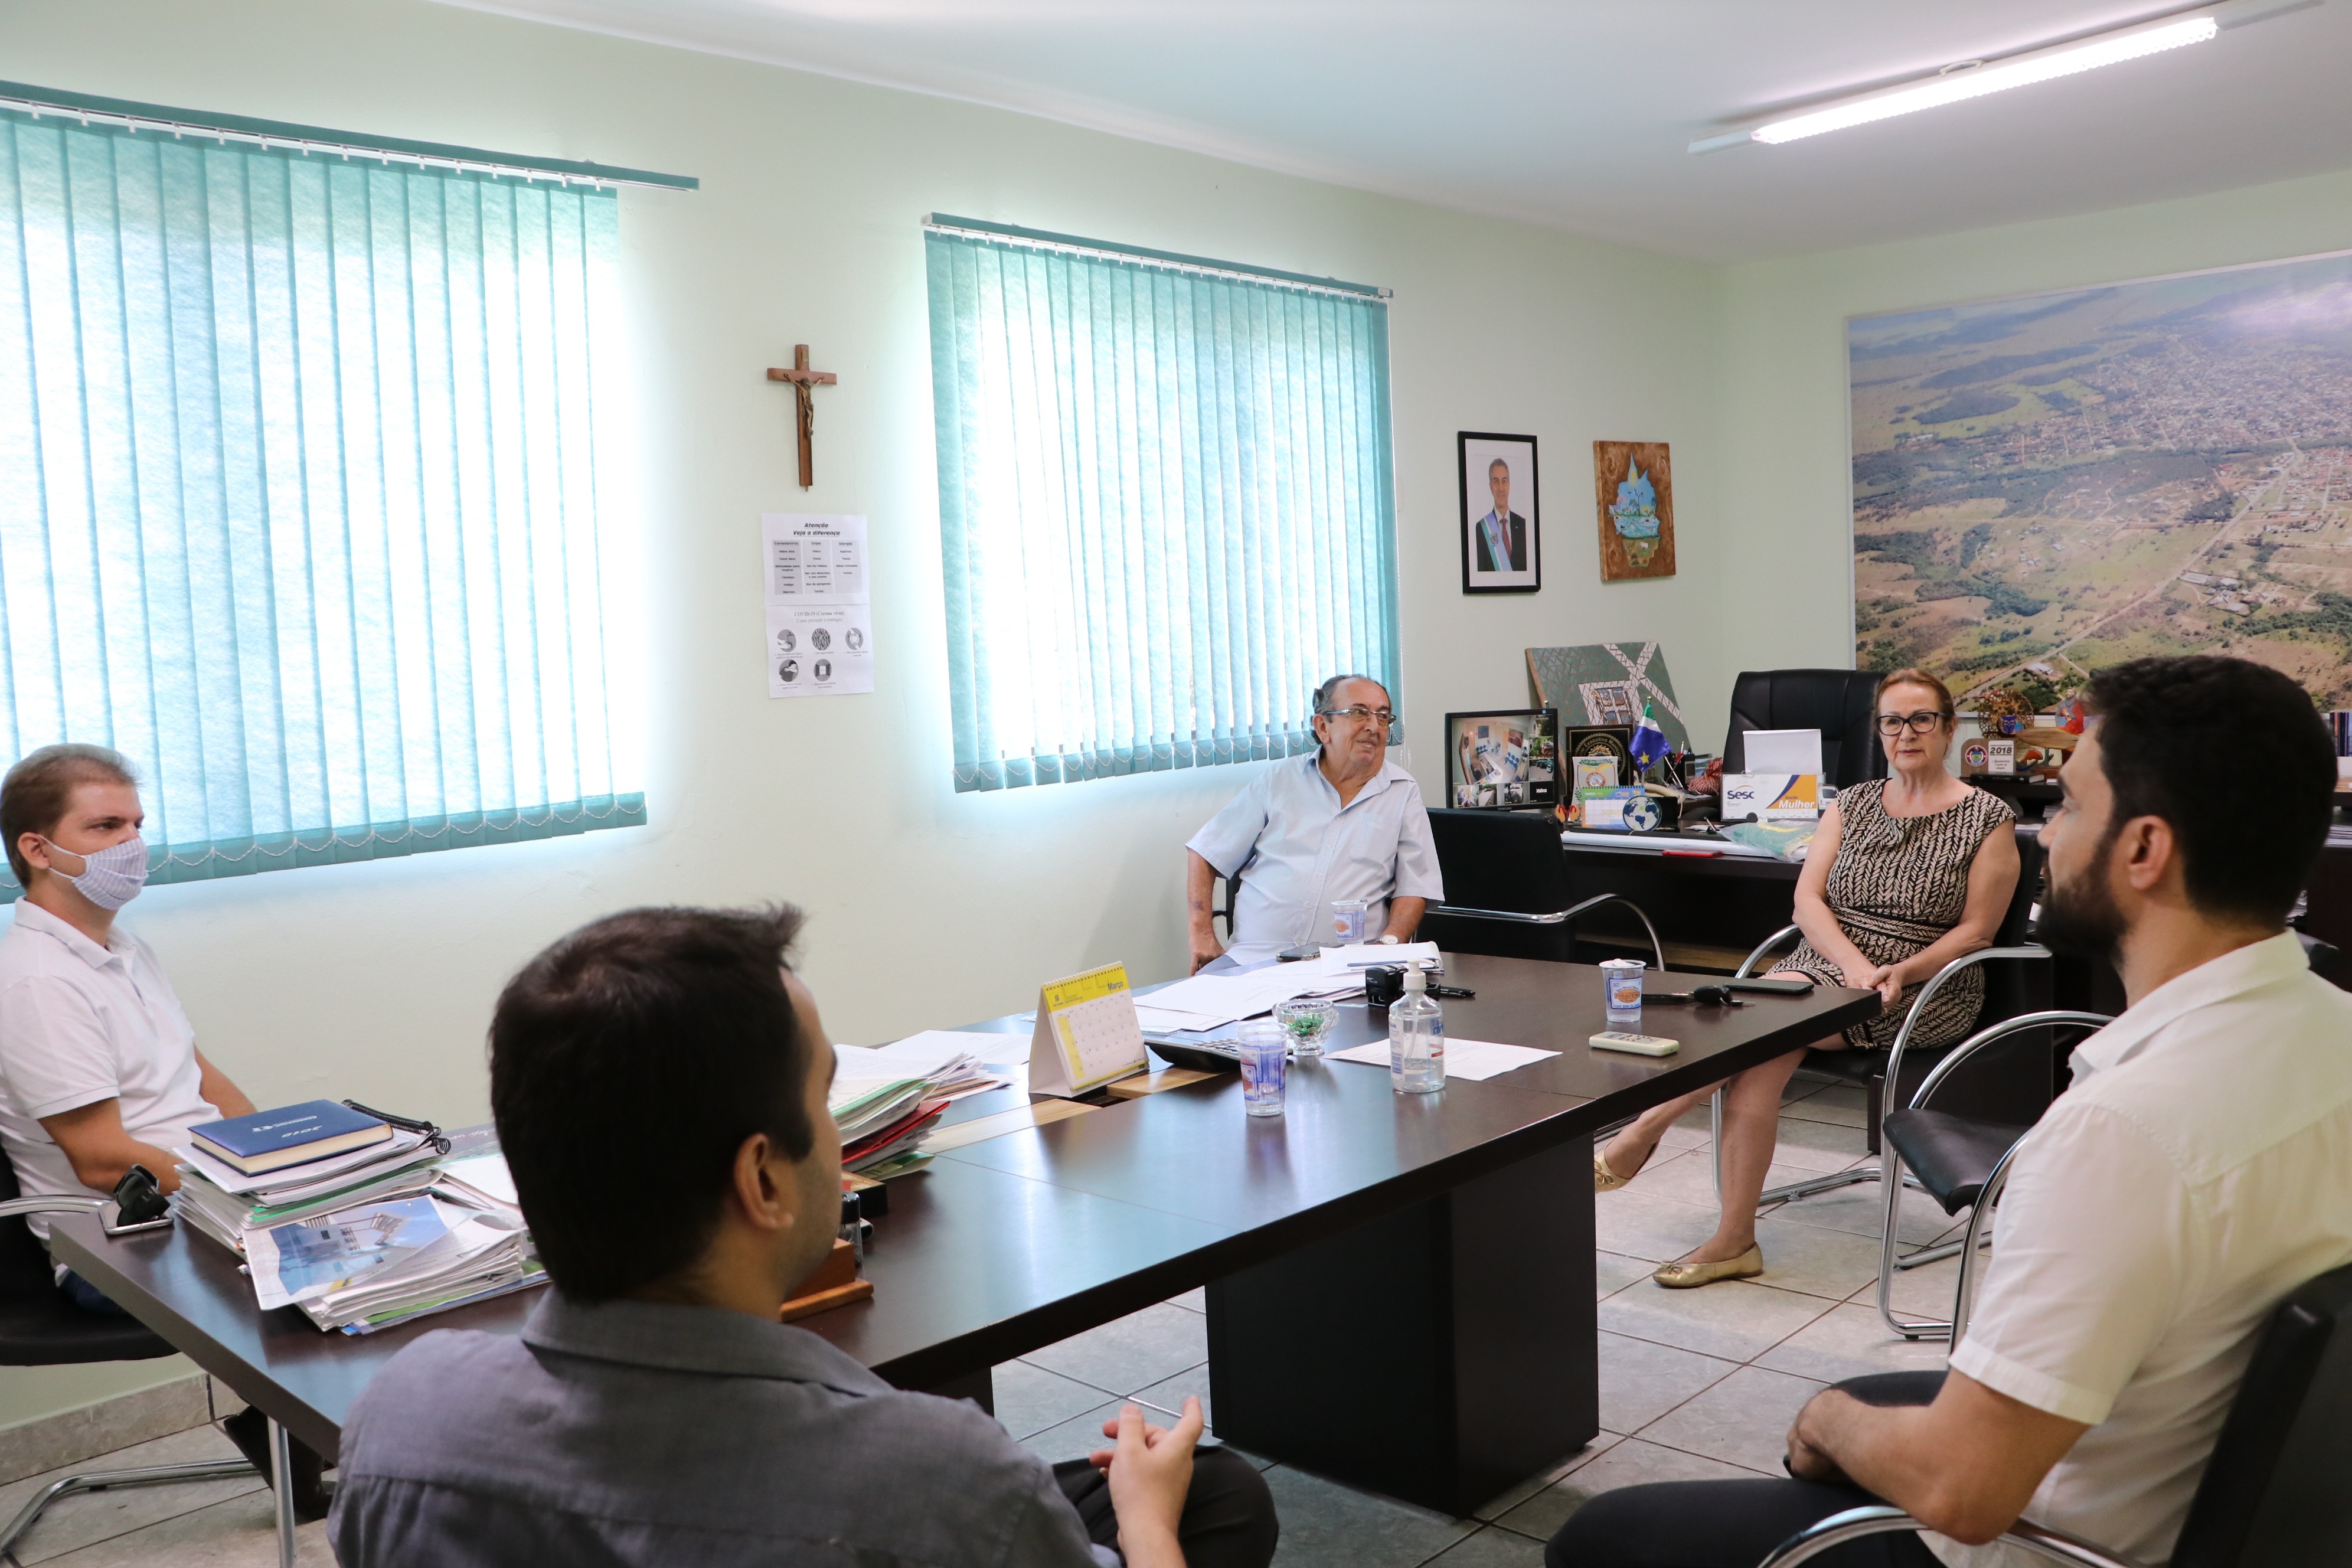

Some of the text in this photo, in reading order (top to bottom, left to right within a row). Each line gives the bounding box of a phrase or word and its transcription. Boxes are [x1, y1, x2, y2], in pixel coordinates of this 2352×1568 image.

[1584, 737, 1622, 761] Executivo Municipal
[1727, 790, 1755, 799] Sesc
[1778, 800, 1815, 808] Mulher
[1107, 981, 1124, 991] Março
[282, 1125, 322, 1138] 2018
